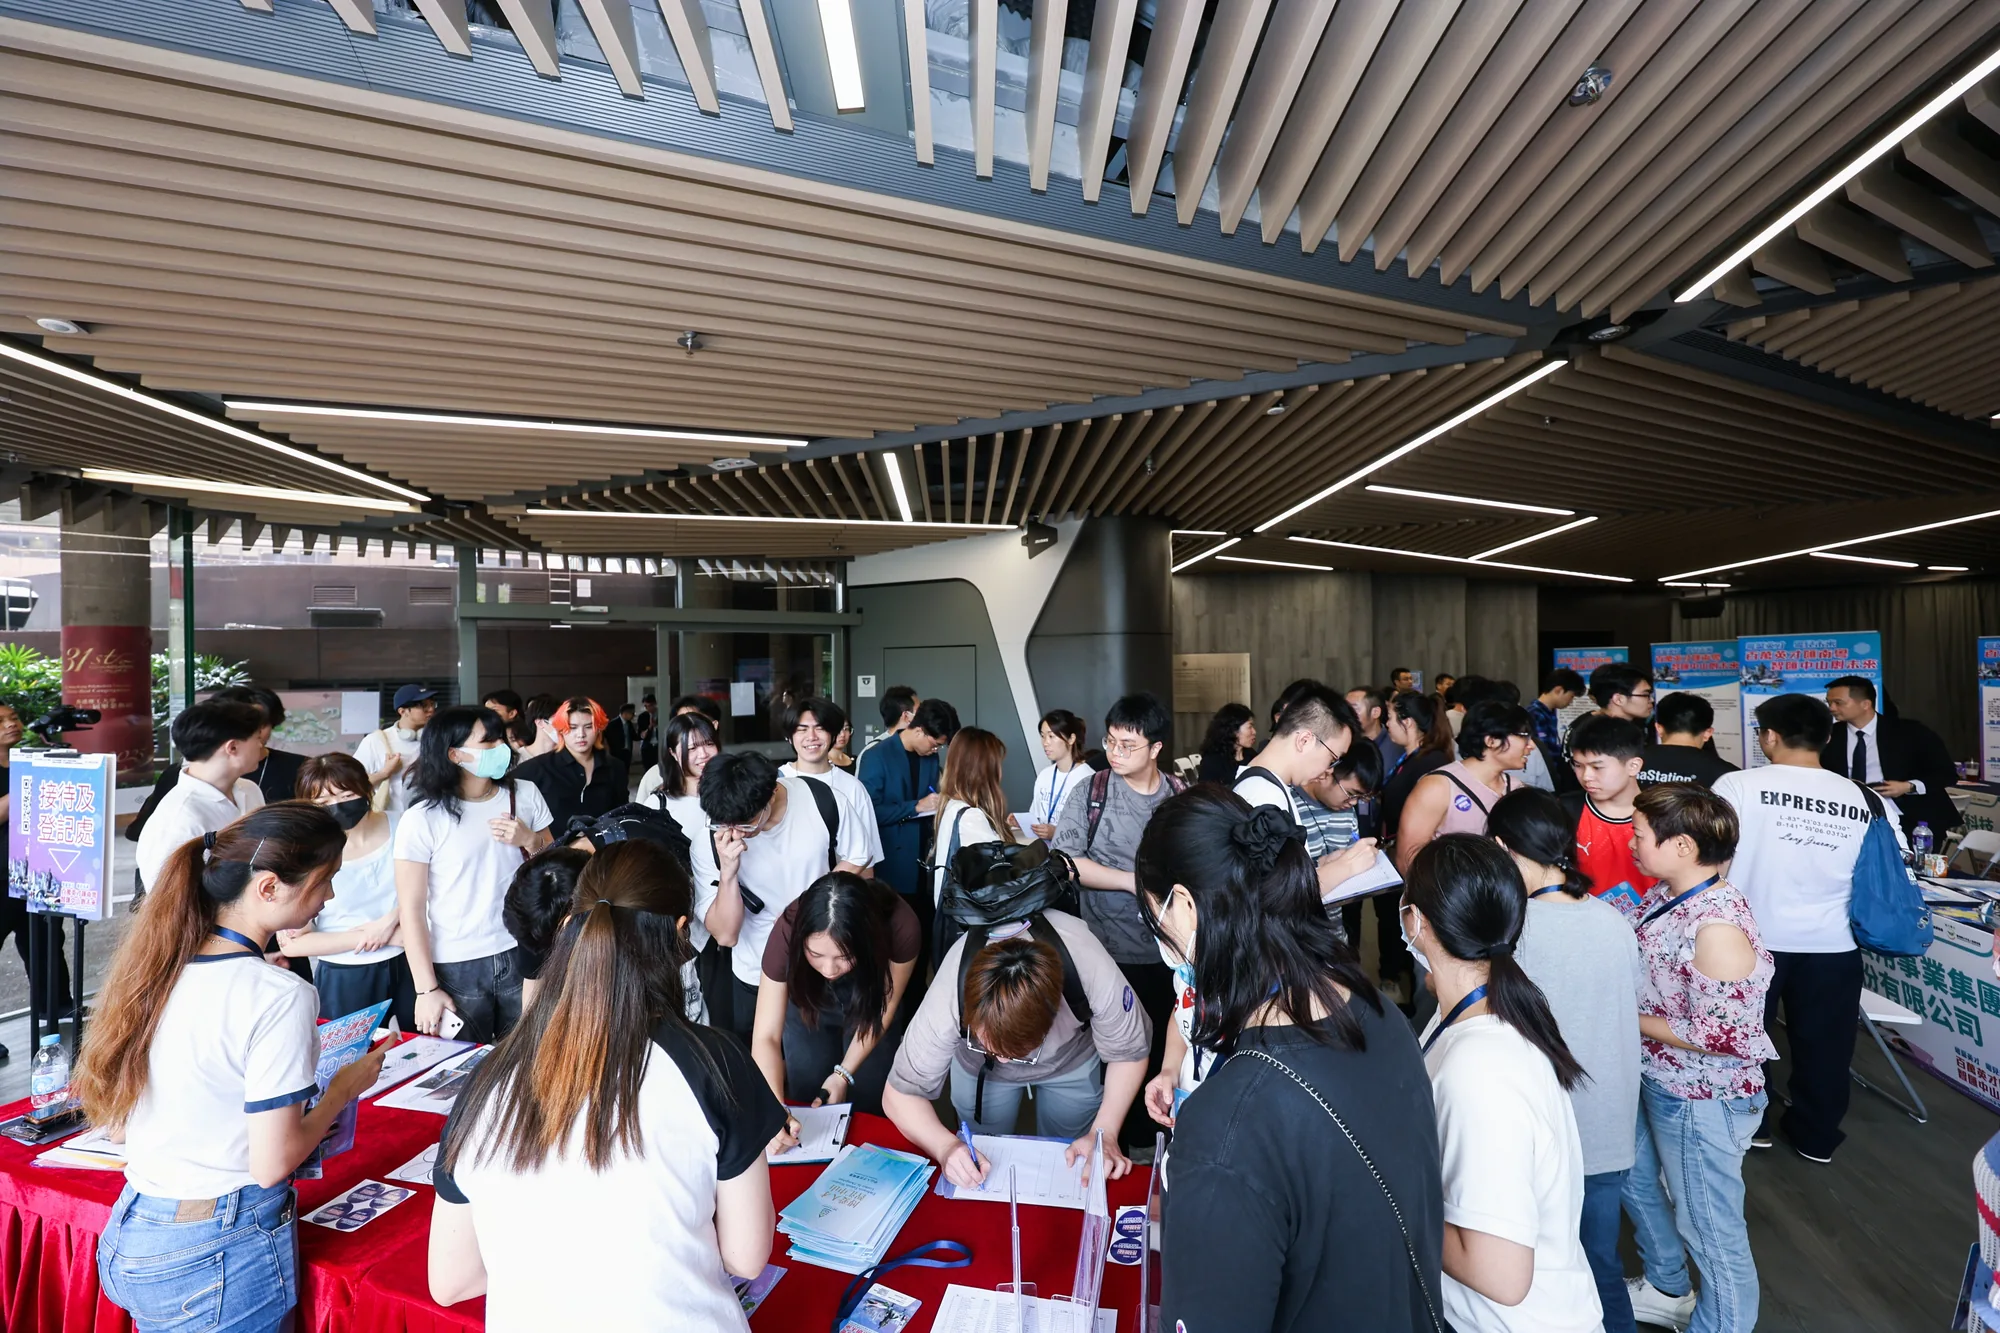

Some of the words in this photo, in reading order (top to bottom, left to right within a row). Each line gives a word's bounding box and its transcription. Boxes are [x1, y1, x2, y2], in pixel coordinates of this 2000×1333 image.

[39, 781, 95, 811] 接待及
[1760, 790, 1871, 825] EXPRESSION
[38, 814, 94, 846] 登記處
